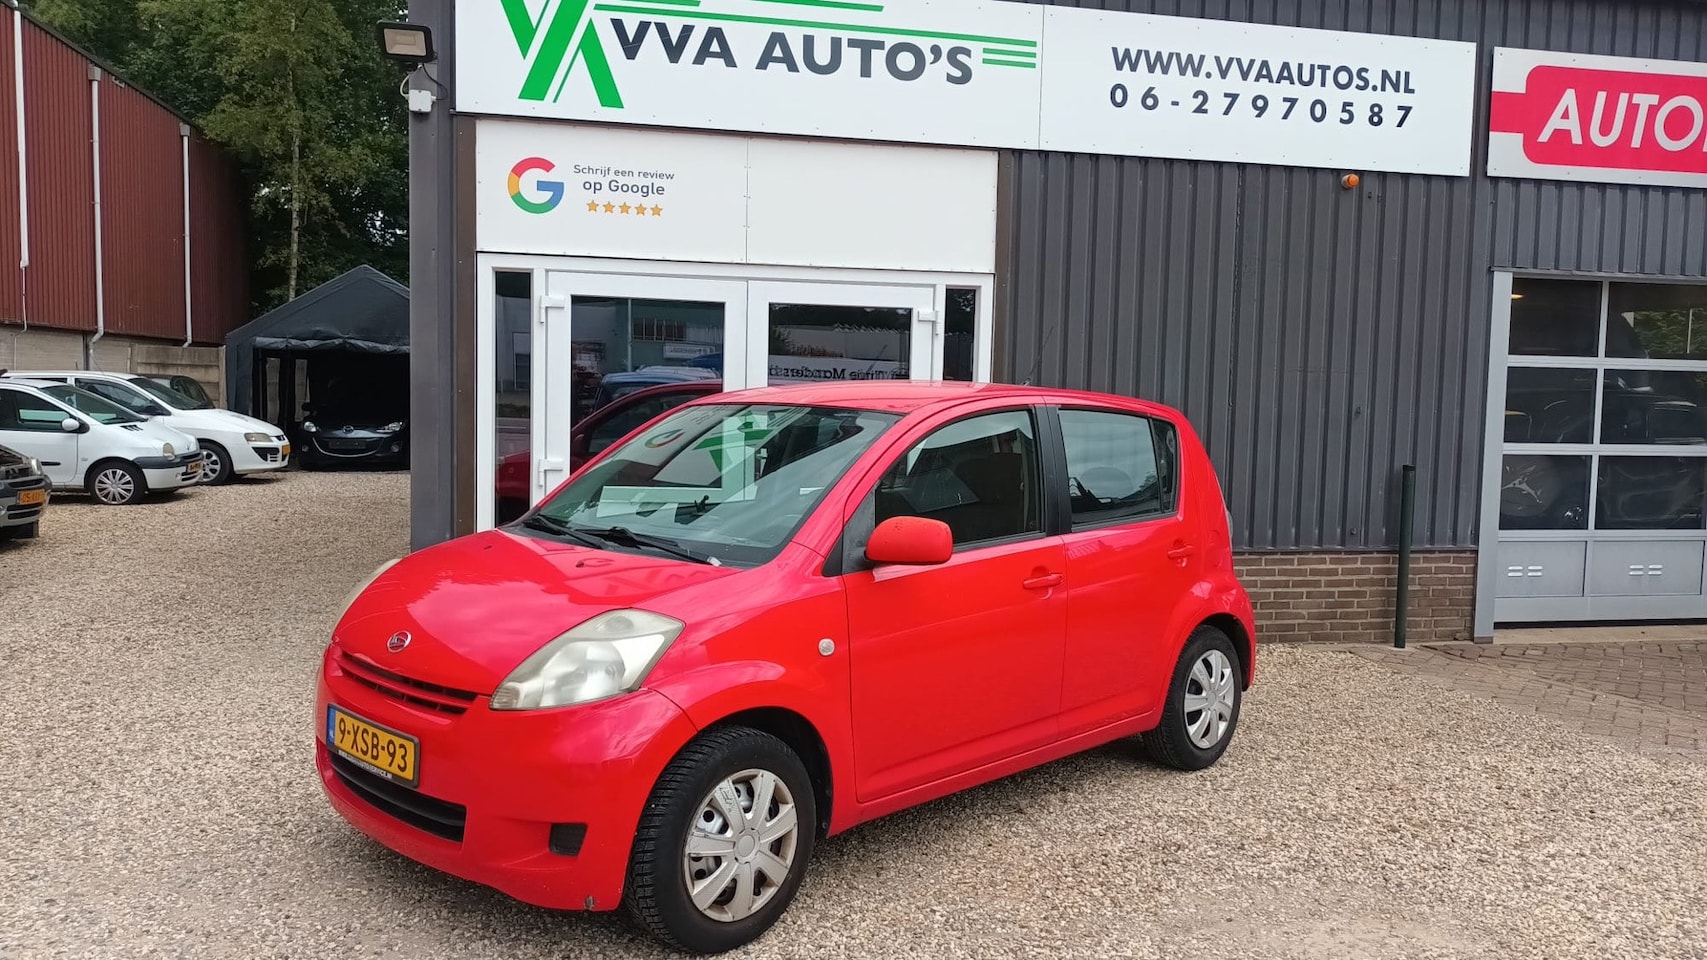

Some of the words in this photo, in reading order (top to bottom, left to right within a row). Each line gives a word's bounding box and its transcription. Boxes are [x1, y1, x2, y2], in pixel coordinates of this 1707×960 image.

[609, 18, 738, 68] VVA
[755, 31, 974, 85] AUTO'S
[1111, 46, 1415, 94] WWW.VVAAUTOS.NL
[1537, 88, 1707, 153] AUTO
[573, 164, 612, 178] Schrijf
[614, 169, 634, 178] een
[637, 170, 675, 181] review
[583, 180, 603, 194] op
[608, 179, 666, 198] Google
[338, 717, 408, 773] 9-XSB-93
